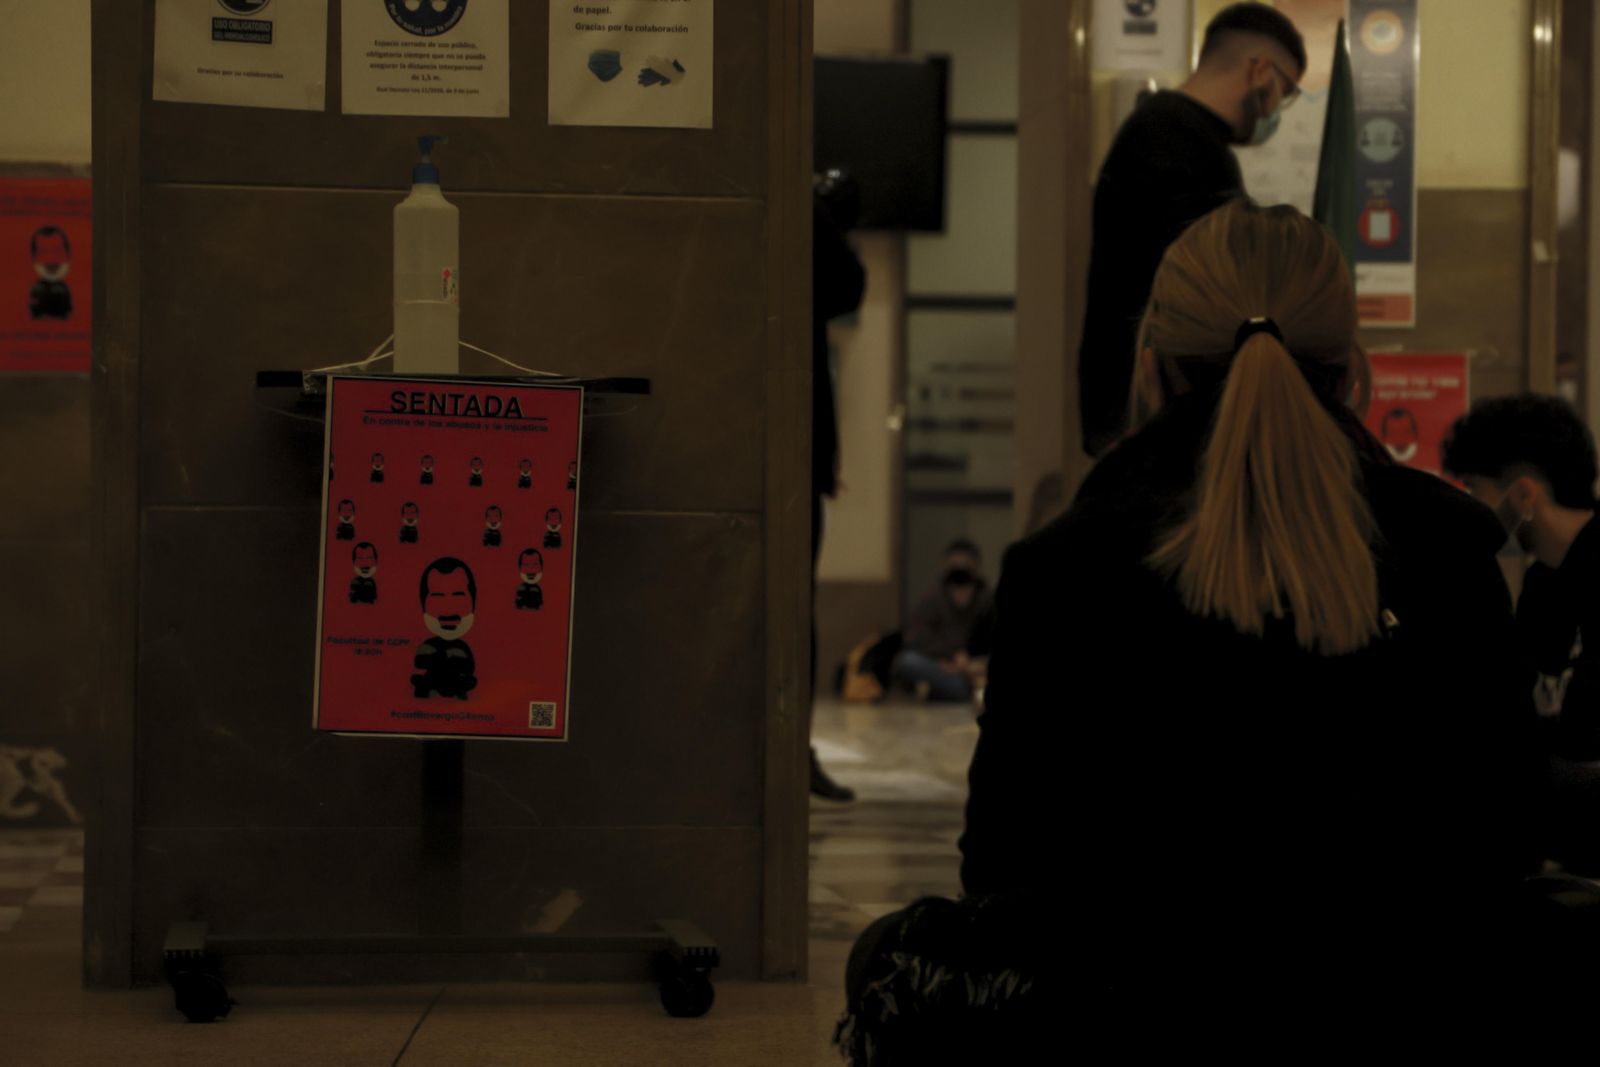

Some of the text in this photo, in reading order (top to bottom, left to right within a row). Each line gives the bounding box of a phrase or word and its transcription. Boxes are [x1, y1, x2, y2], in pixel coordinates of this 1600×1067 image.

[573, 5, 612, 16] de papel.
[229, 20, 270, 32] OBLIGATORIO
[575, 22, 689, 33] Gracias por tu colaboración
[390, 390, 522, 418] SENTADA
[363, 415, 376, 425] En
[413, 417, 425, 426] de
